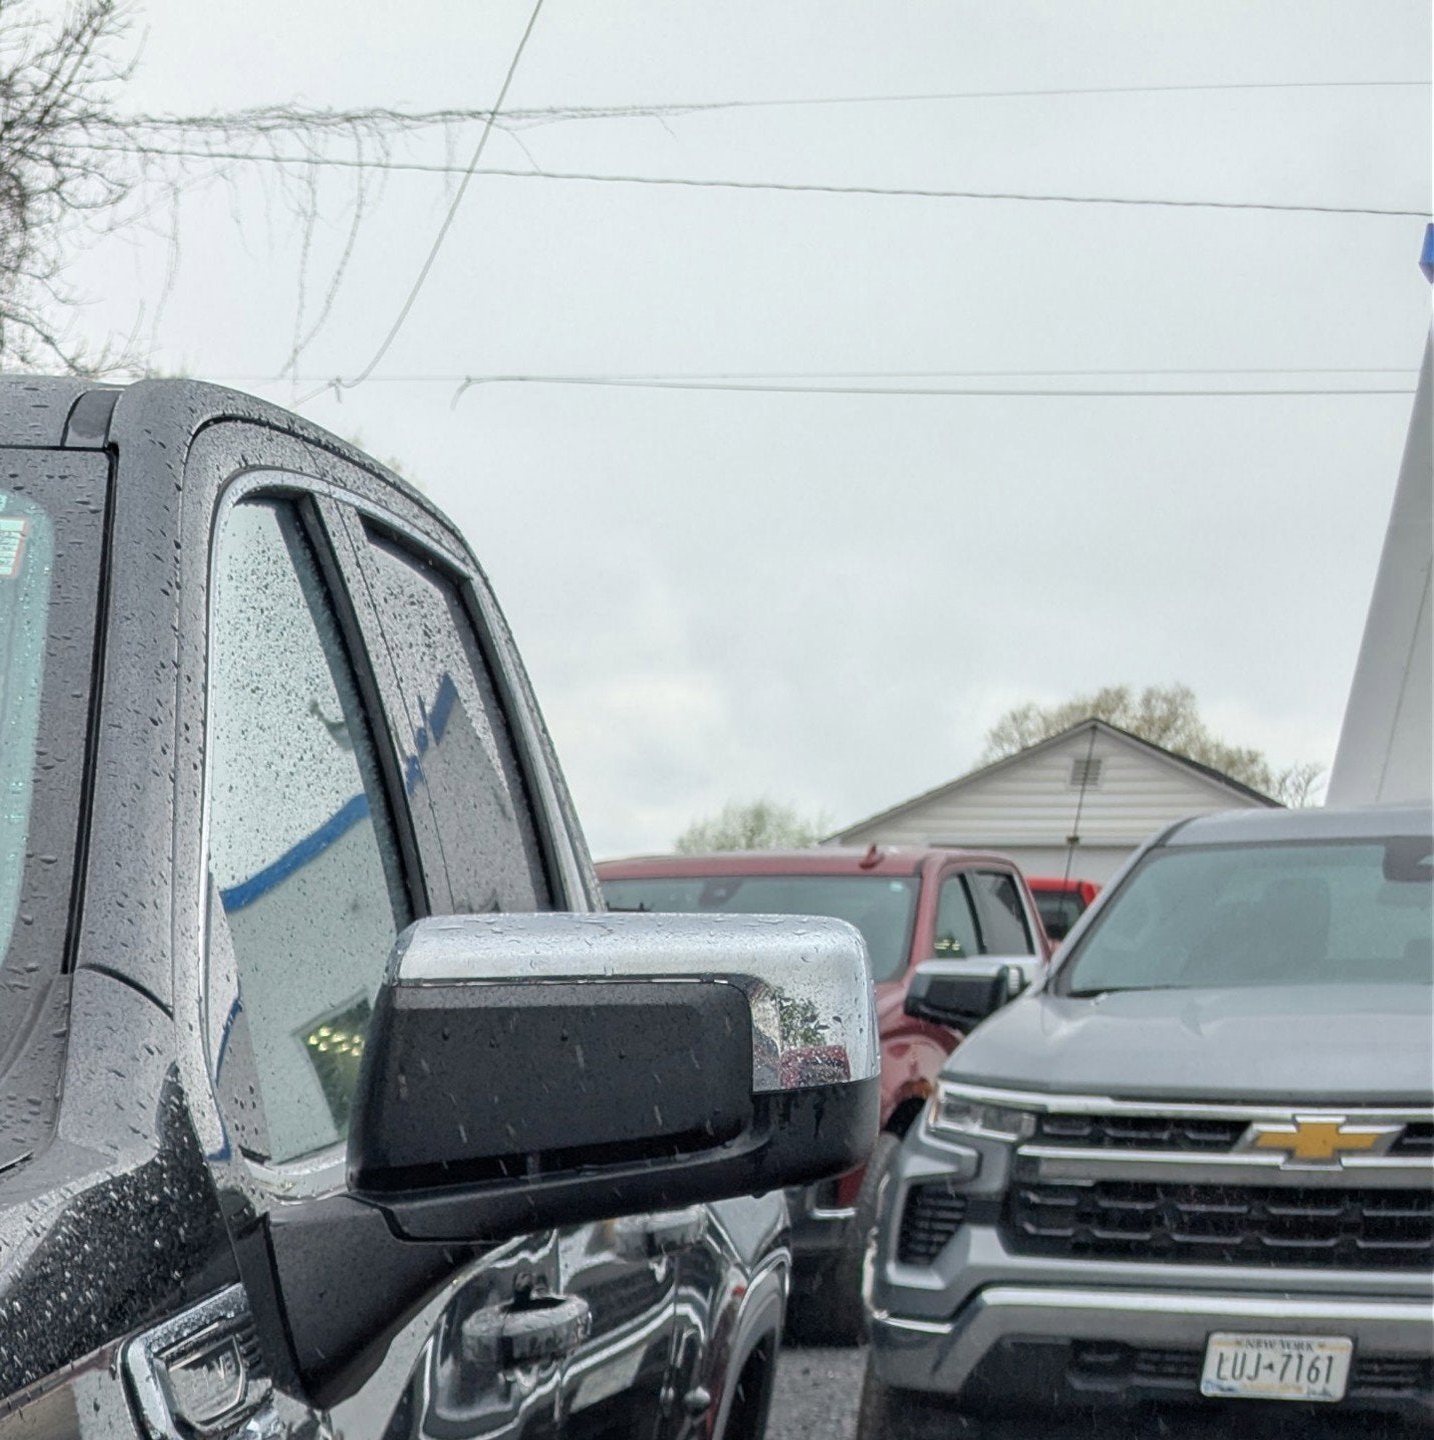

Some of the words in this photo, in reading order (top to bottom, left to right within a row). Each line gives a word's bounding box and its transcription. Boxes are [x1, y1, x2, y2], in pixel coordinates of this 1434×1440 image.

[1245, 1339, 1276, 1350] NEW
[1281, 1340, 1314, 1352] YORK
[1279, 1353, 1334, 1385] 7161
